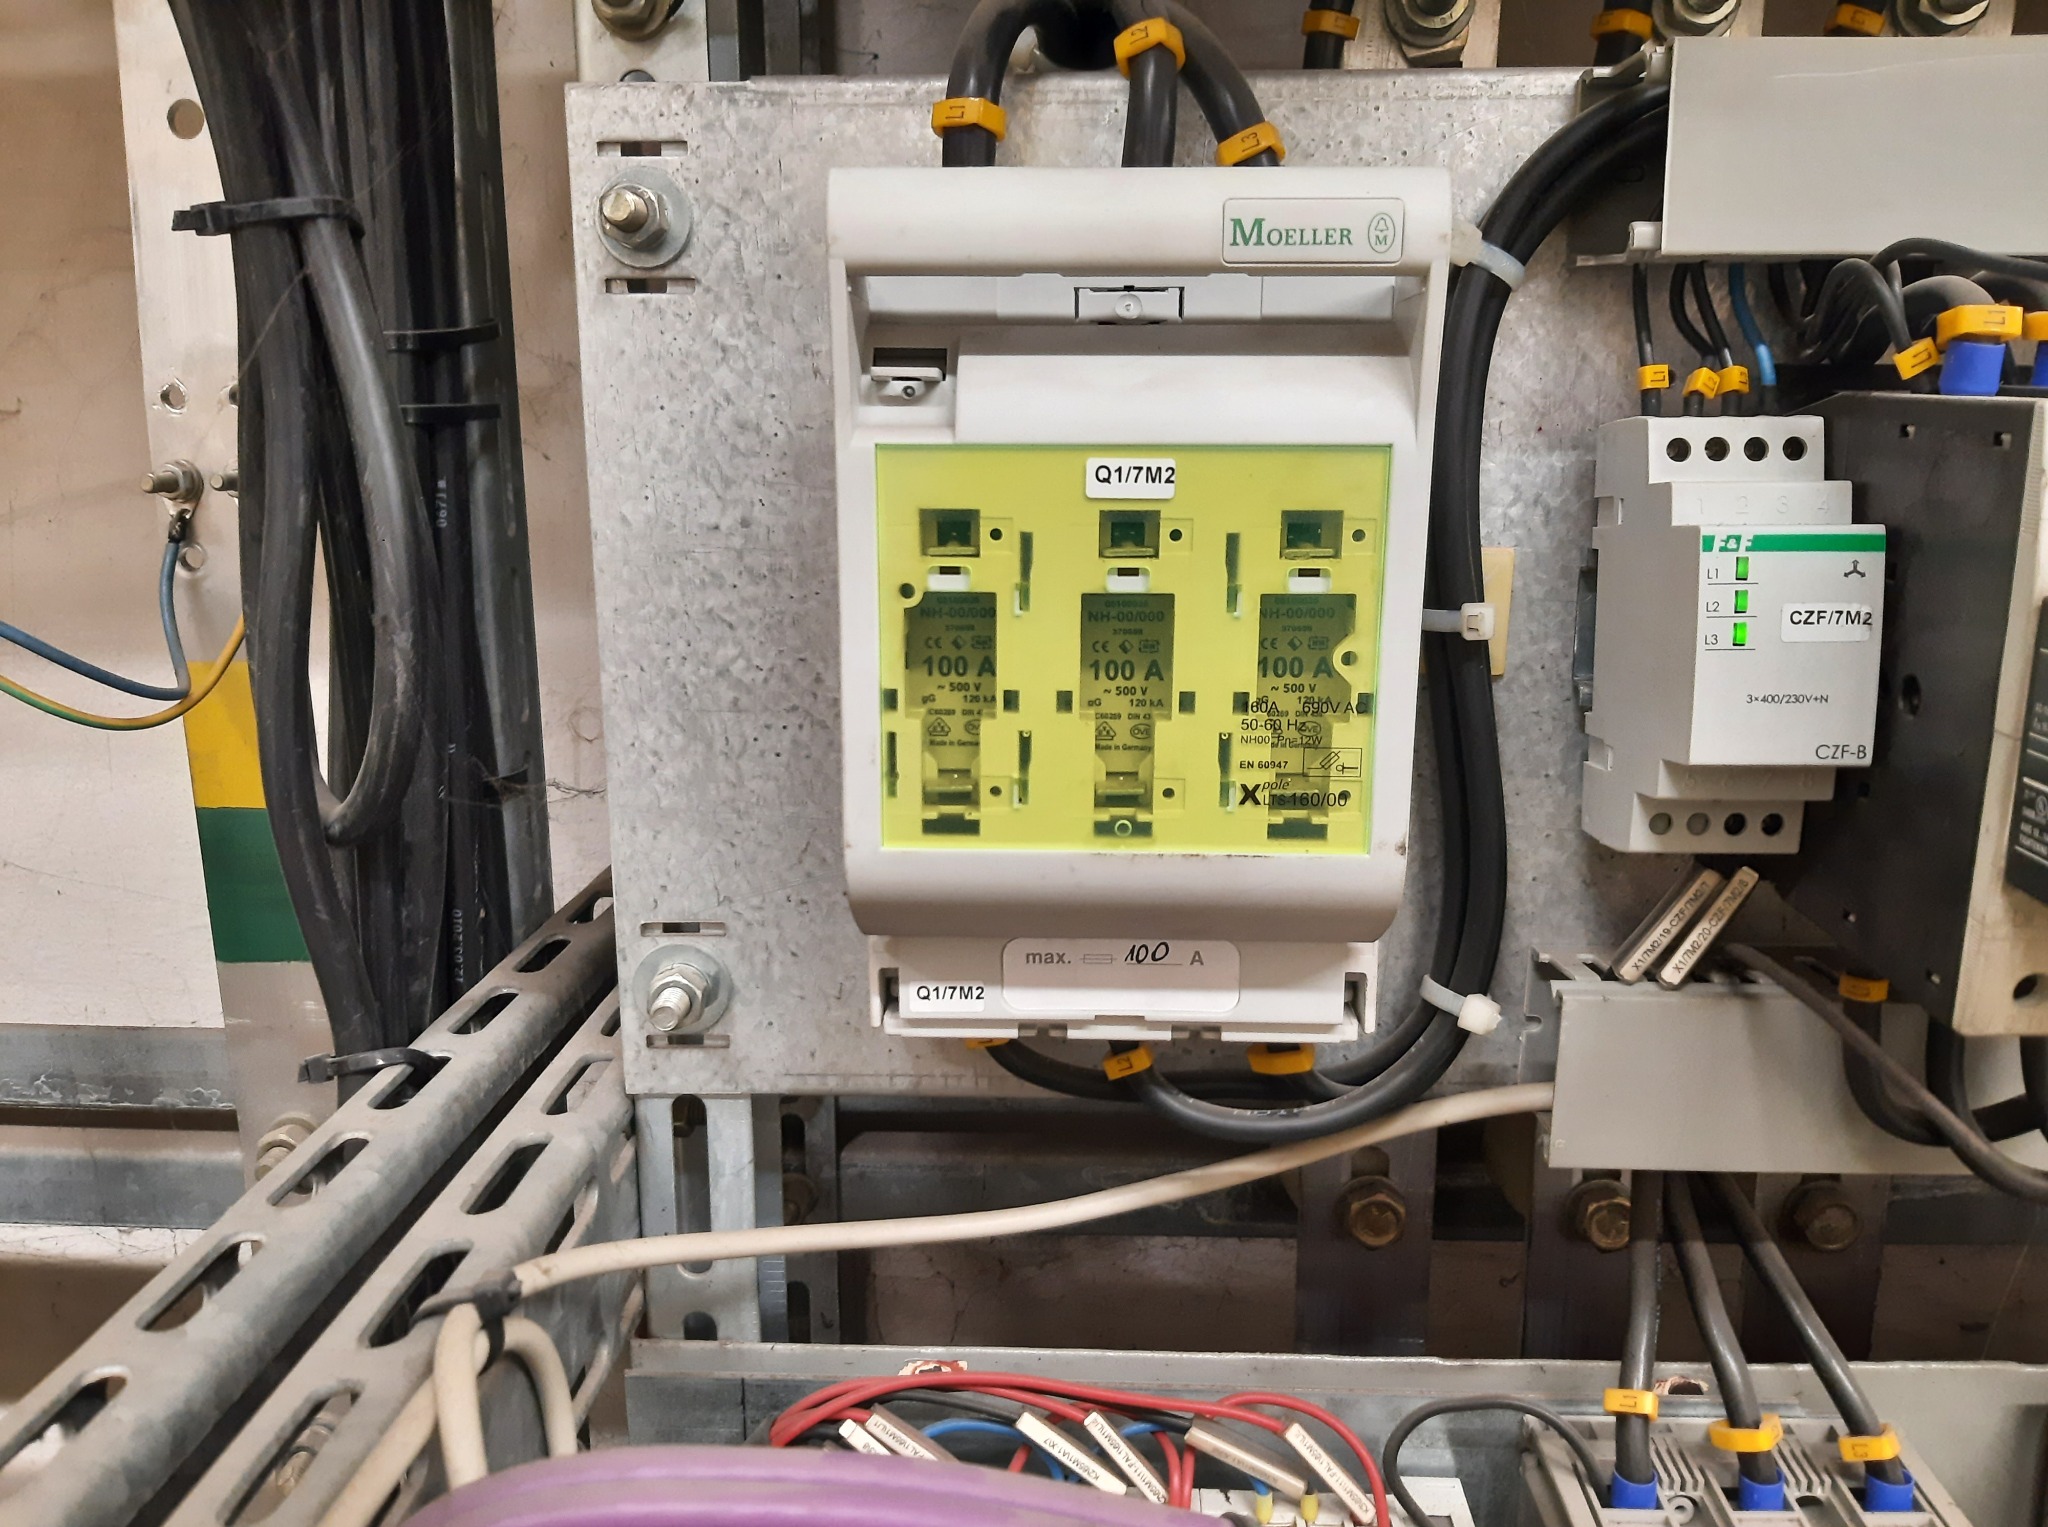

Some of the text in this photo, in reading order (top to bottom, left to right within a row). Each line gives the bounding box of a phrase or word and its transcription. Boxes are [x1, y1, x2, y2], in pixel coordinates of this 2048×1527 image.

[1129, 24, 1149, 46] L2
[945, 104, 966, 120] L1
[1241, 131, 1260, 153] L3
[1982, 309, 2006, 325] L1
[1650, 370, 1666, 383] L1
[1094, 465, 1176, 486] Q1/7M2
[1707, 568, 1719, 579] L1
[1706, 601, 1720, 613] L2
[1087, 610, 1165, 623] NH-00/000
[1789, 610, 1874, 626] CZF/7M2
[1704, 634, 1719, 645] L3
[922, 655, 996, 677] 100 A
[1089, 659, 1165, 682] 100 A
[1258, 656, 1334, 678] 100 A
[949, 682, 971, 692] 500
[973, 682, 982, 692] V
[1115, 686, 1138, 696] 500
[1140, 686, 1148, 696] V
[1283, 683, 1305, 693] 500
[1308, 683, 1317, 693] V
[1129, 698, 1147, 707] 120
[1149, 698, 1164, 707] kA
[1244, 701, 1280, 713] 160A
[1302, 701, 1340, 714] 690V
[1343, 701, 1367, 714] AC
[1240, 718, 1308, 731] 50-60 Hz
[1815, 744, 1868, 760] CZF-B
[1239, 760, 1289, 769] EN 60947
[1261, 779, 1291, 793] pole
[1025, 940, 1205, 966] max. 100 A
[915, 985, 985, 1001] Q1/7M2
[1117, 1055, 1132, 1073] L2
[1619, 1394, 1638, 1408] L1
